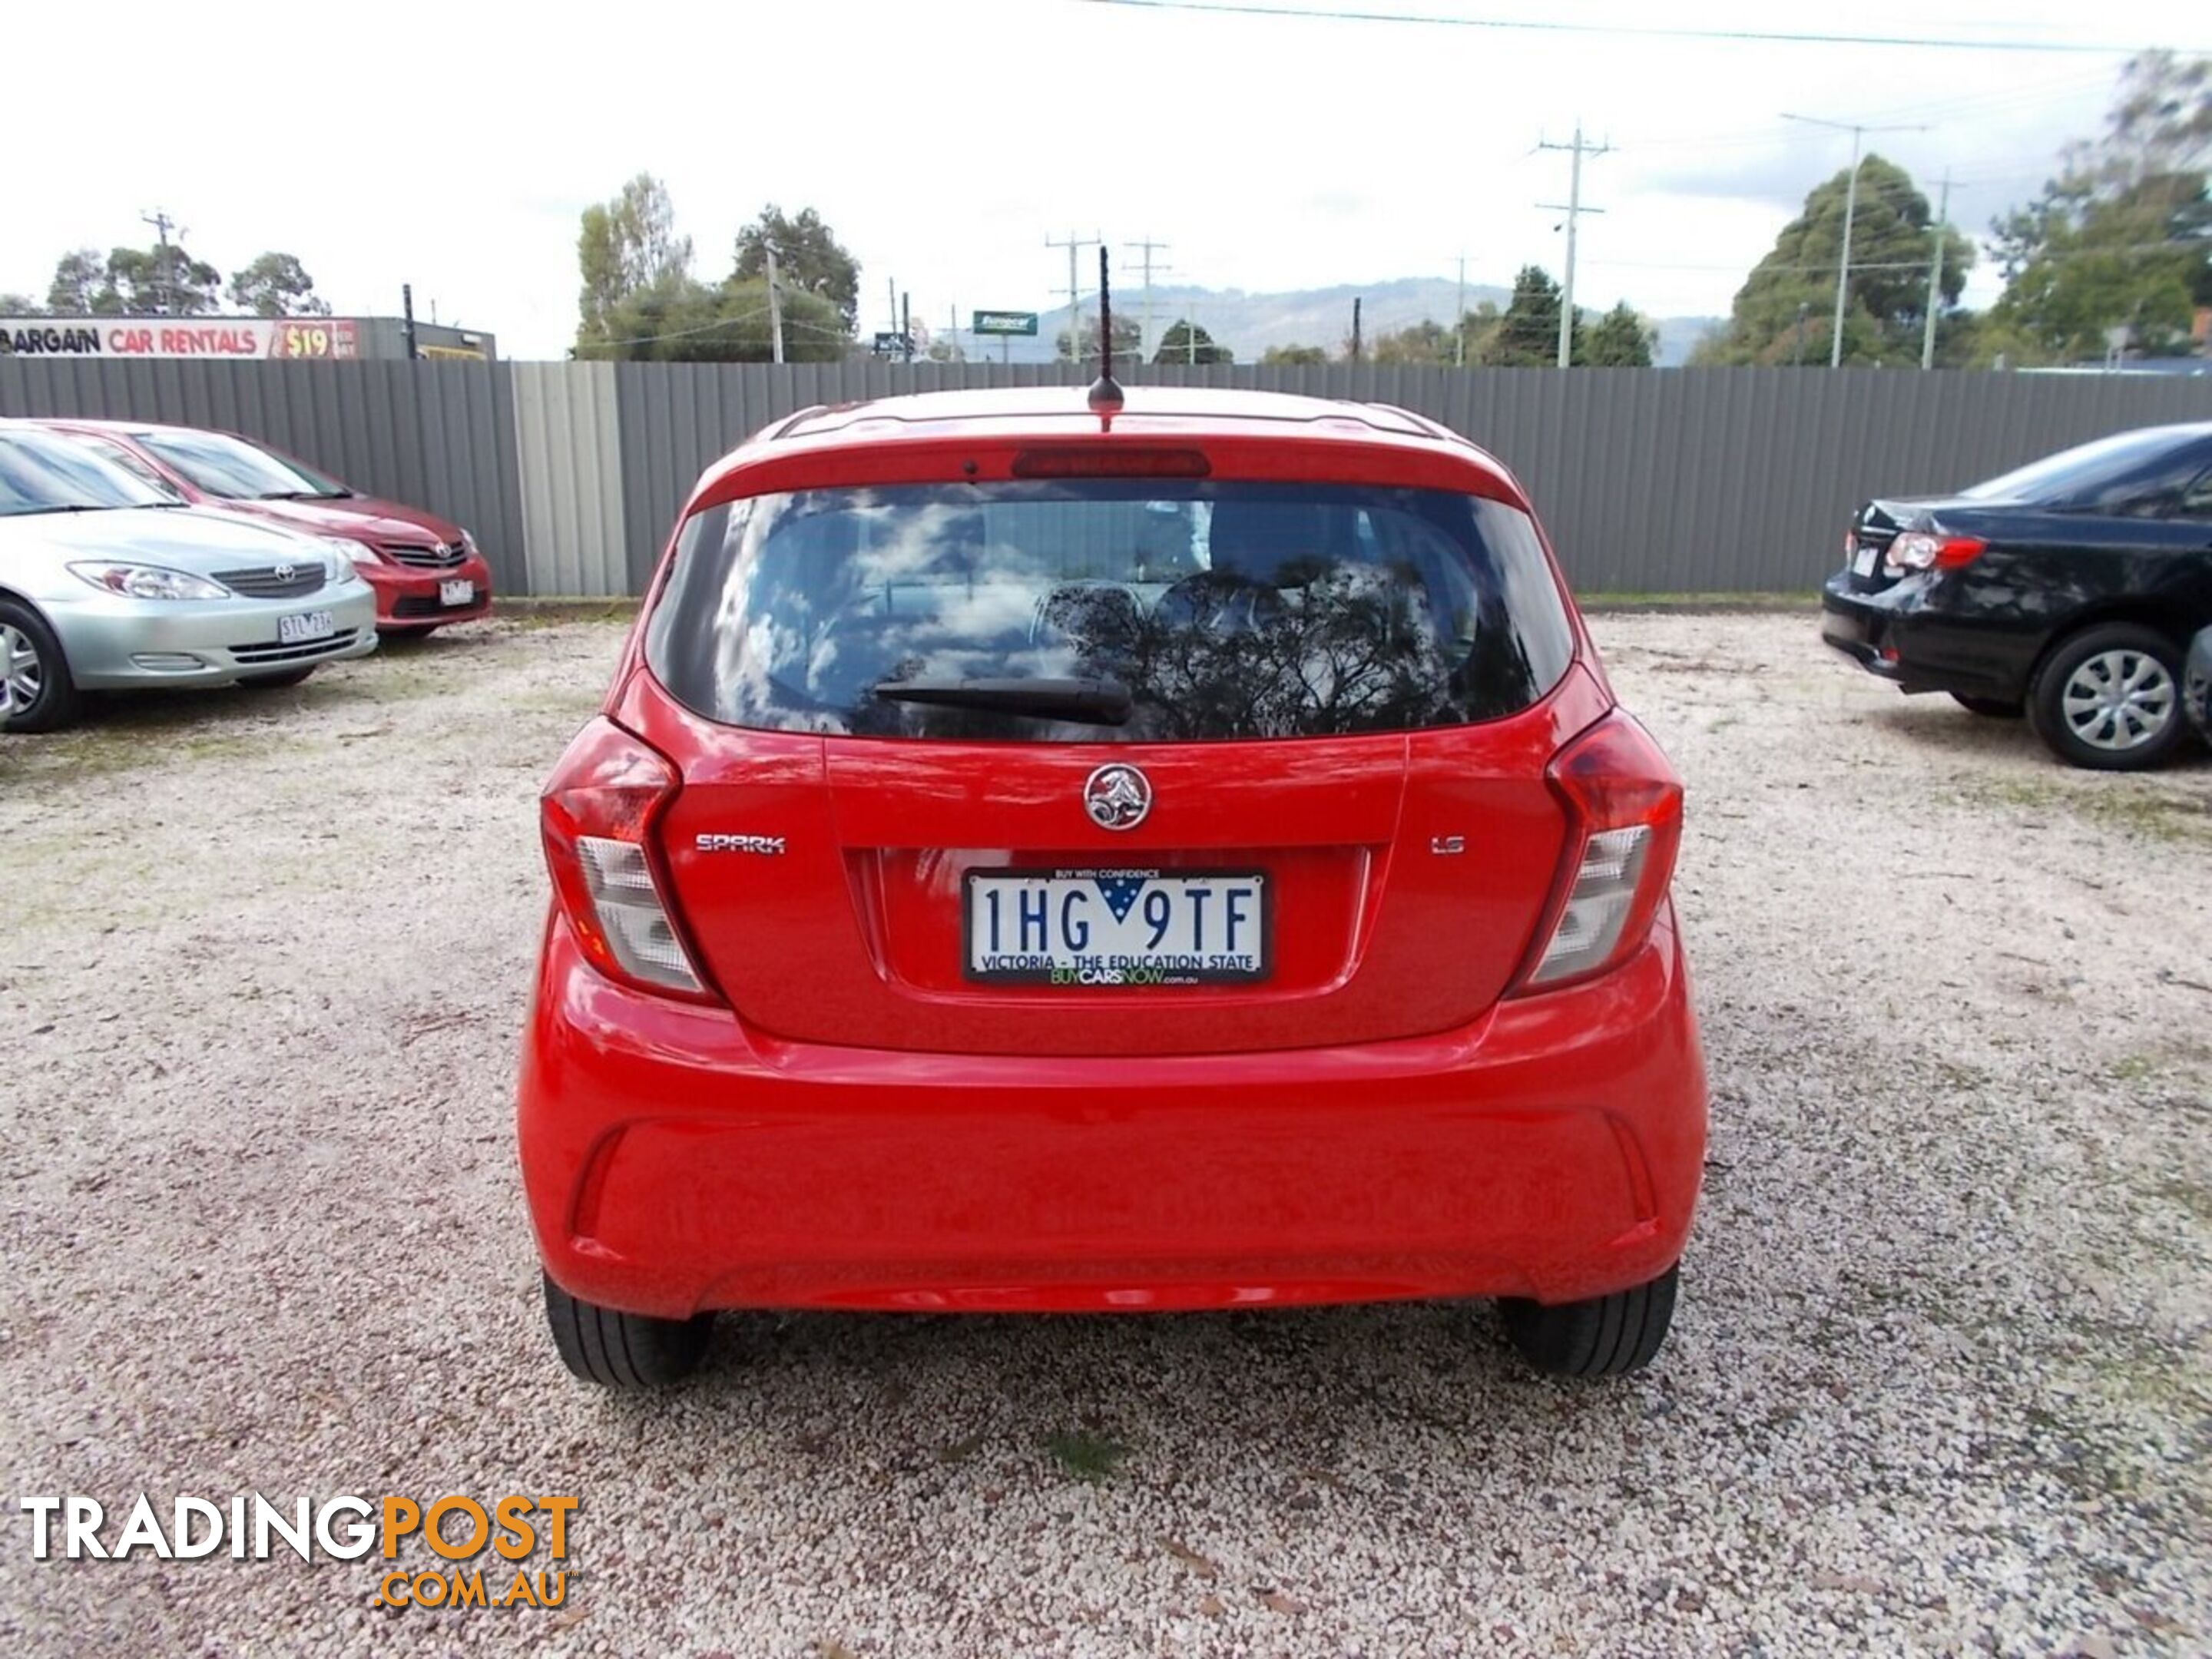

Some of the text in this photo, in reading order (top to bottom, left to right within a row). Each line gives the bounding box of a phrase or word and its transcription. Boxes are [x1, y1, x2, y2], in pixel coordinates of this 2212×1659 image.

[108, 329, 154, 353] CAR
[160, 328, 257, 354] RENTALS
[286, 325, 329, 359] $19
[696, 834, 786, 854] SPARK
[1432, 836, 1465, 854] LS
[1055, 869, 1160, 879] BUY WITH CONFIDENCE
[985, 889, 1253, 952] 1HG 9TF
[982, 955, 1055, 969] VICTORIA
[1073, 955, 1103, 969] THE
[1109, 955, 1203, 969] EDUCATION
[1209, 955, 1253, 969] STATE
